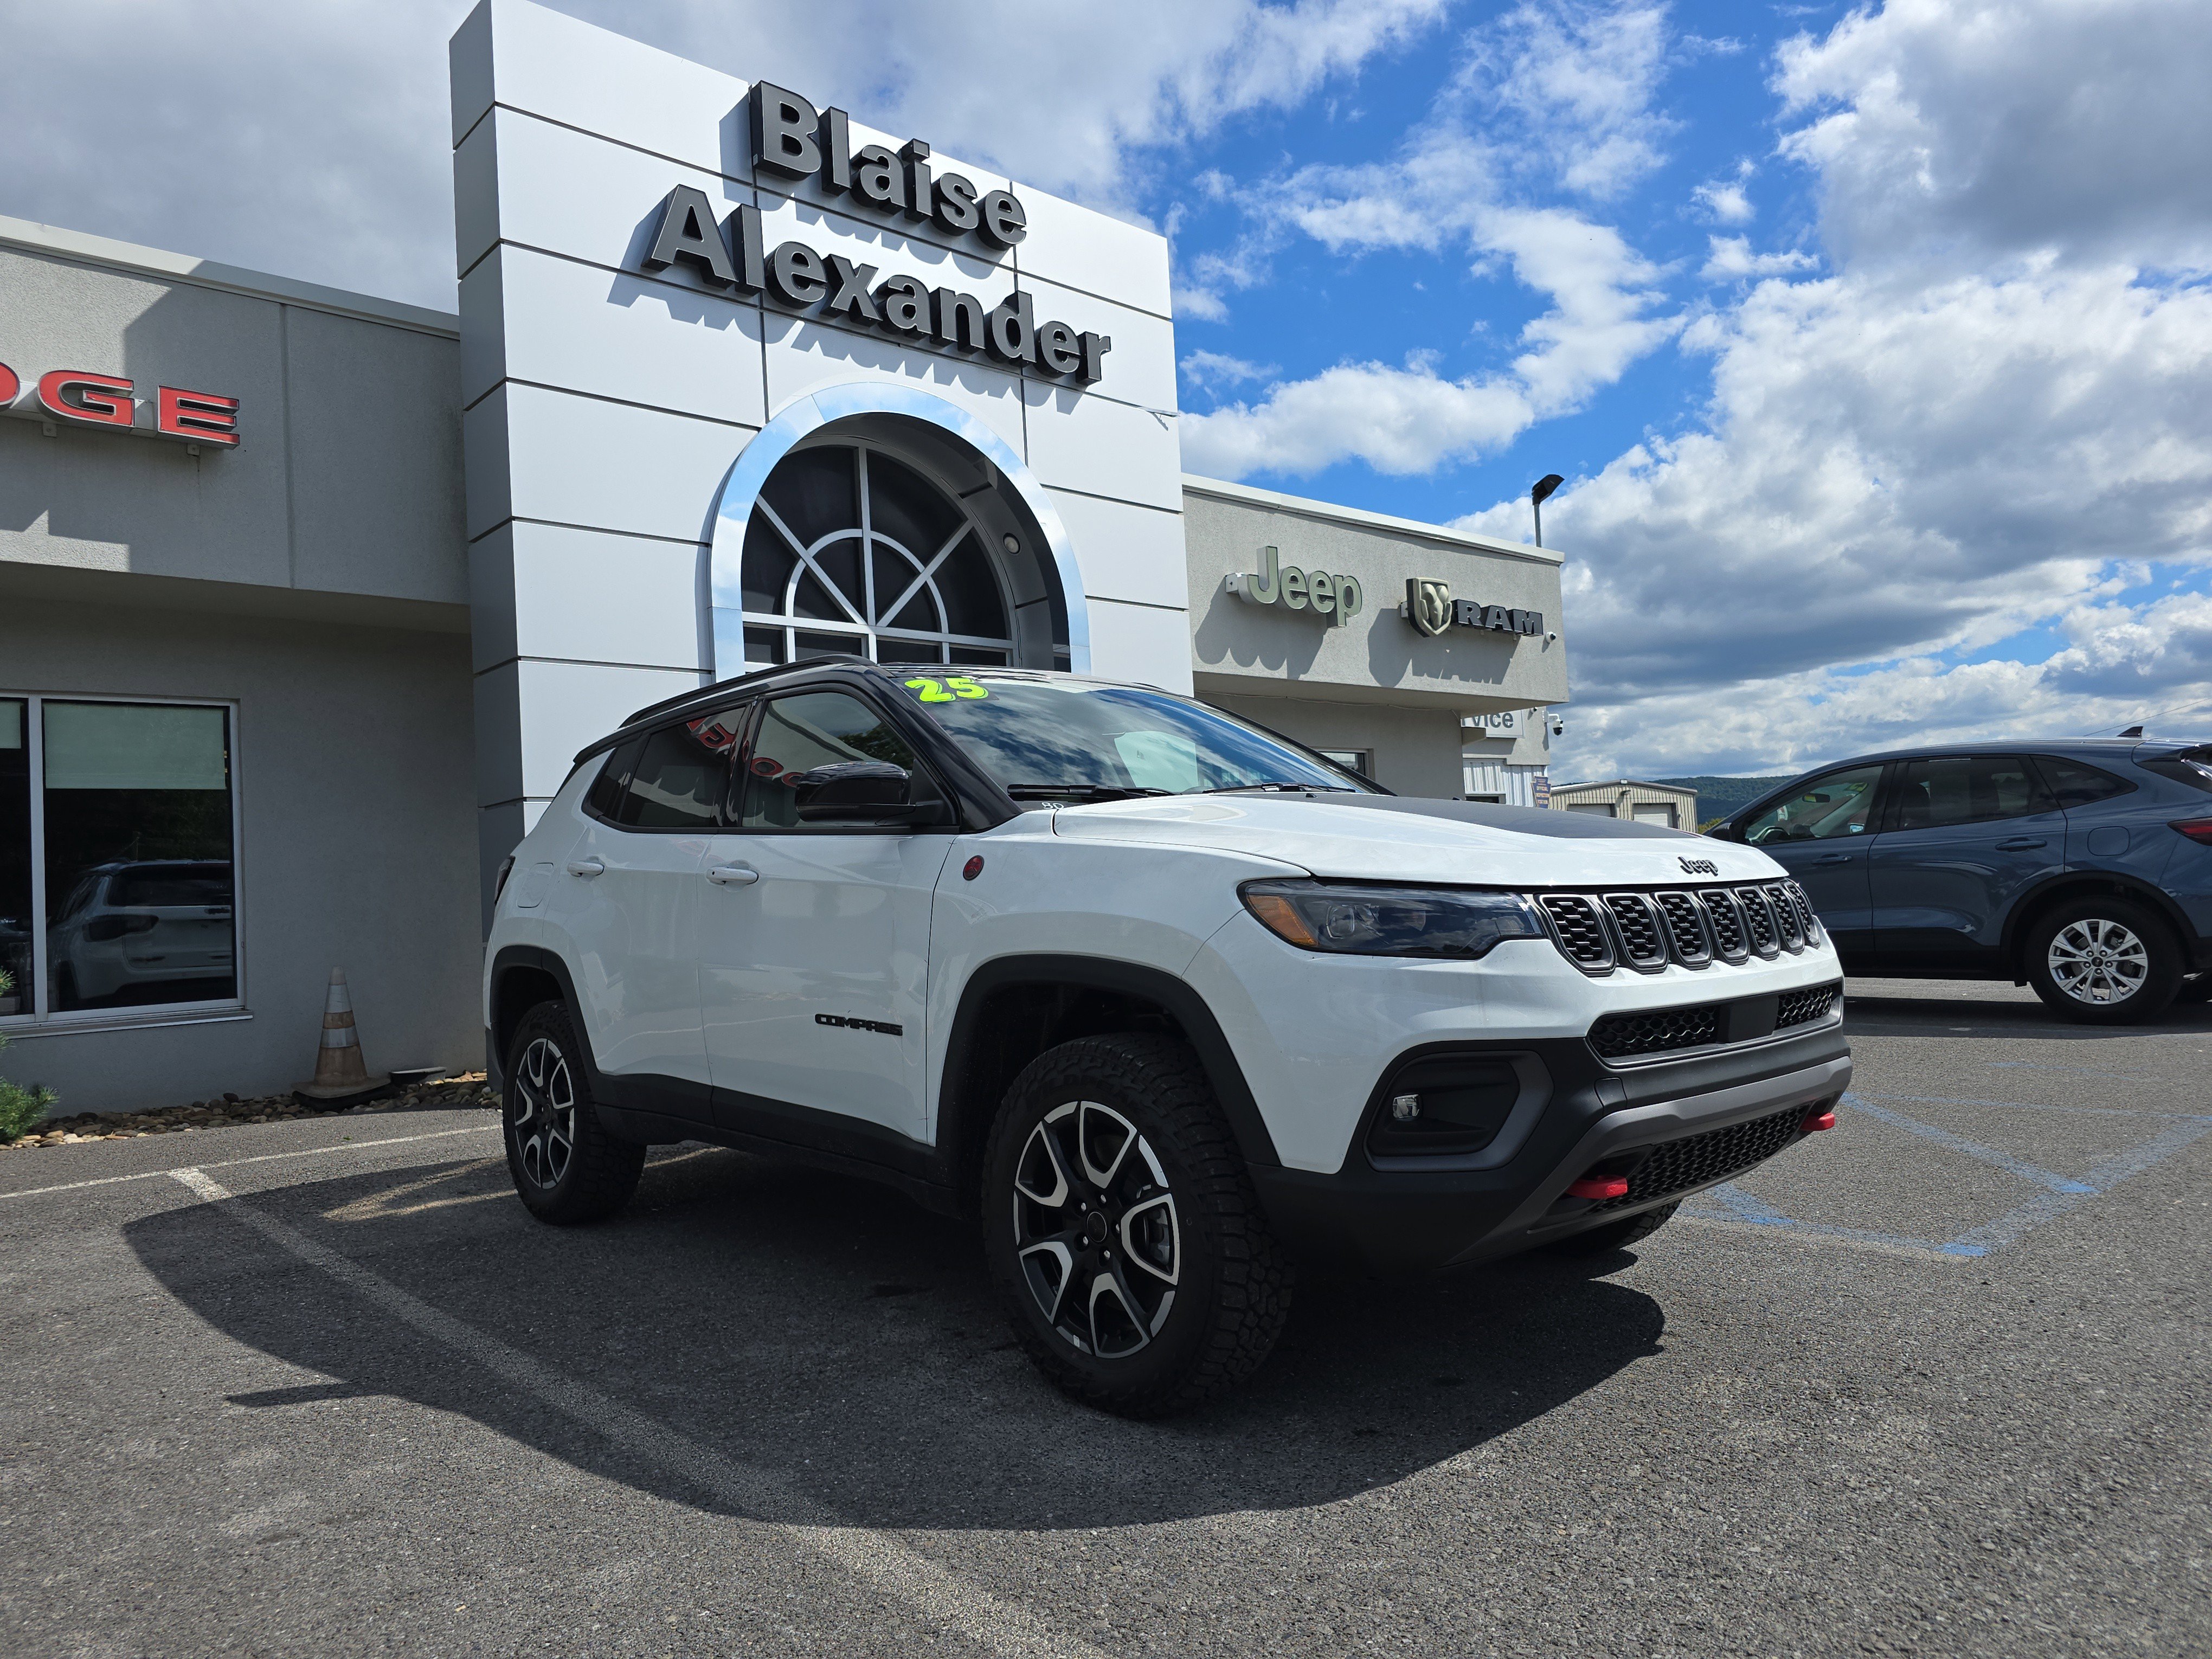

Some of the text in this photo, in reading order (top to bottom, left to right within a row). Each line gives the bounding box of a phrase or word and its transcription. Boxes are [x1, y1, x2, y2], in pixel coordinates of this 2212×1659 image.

[751, 80, 1027, 250] Blaise
[642, 184, 1111, 386] Alexander
[0, 362, 240, 450] GE
[1240, 545, 1362, 628] Jeep
[1453, 599, 1544, 636] RAM
[904, 677, 989, 703] 25
[1677, 856, 1719, 877] Jeep
